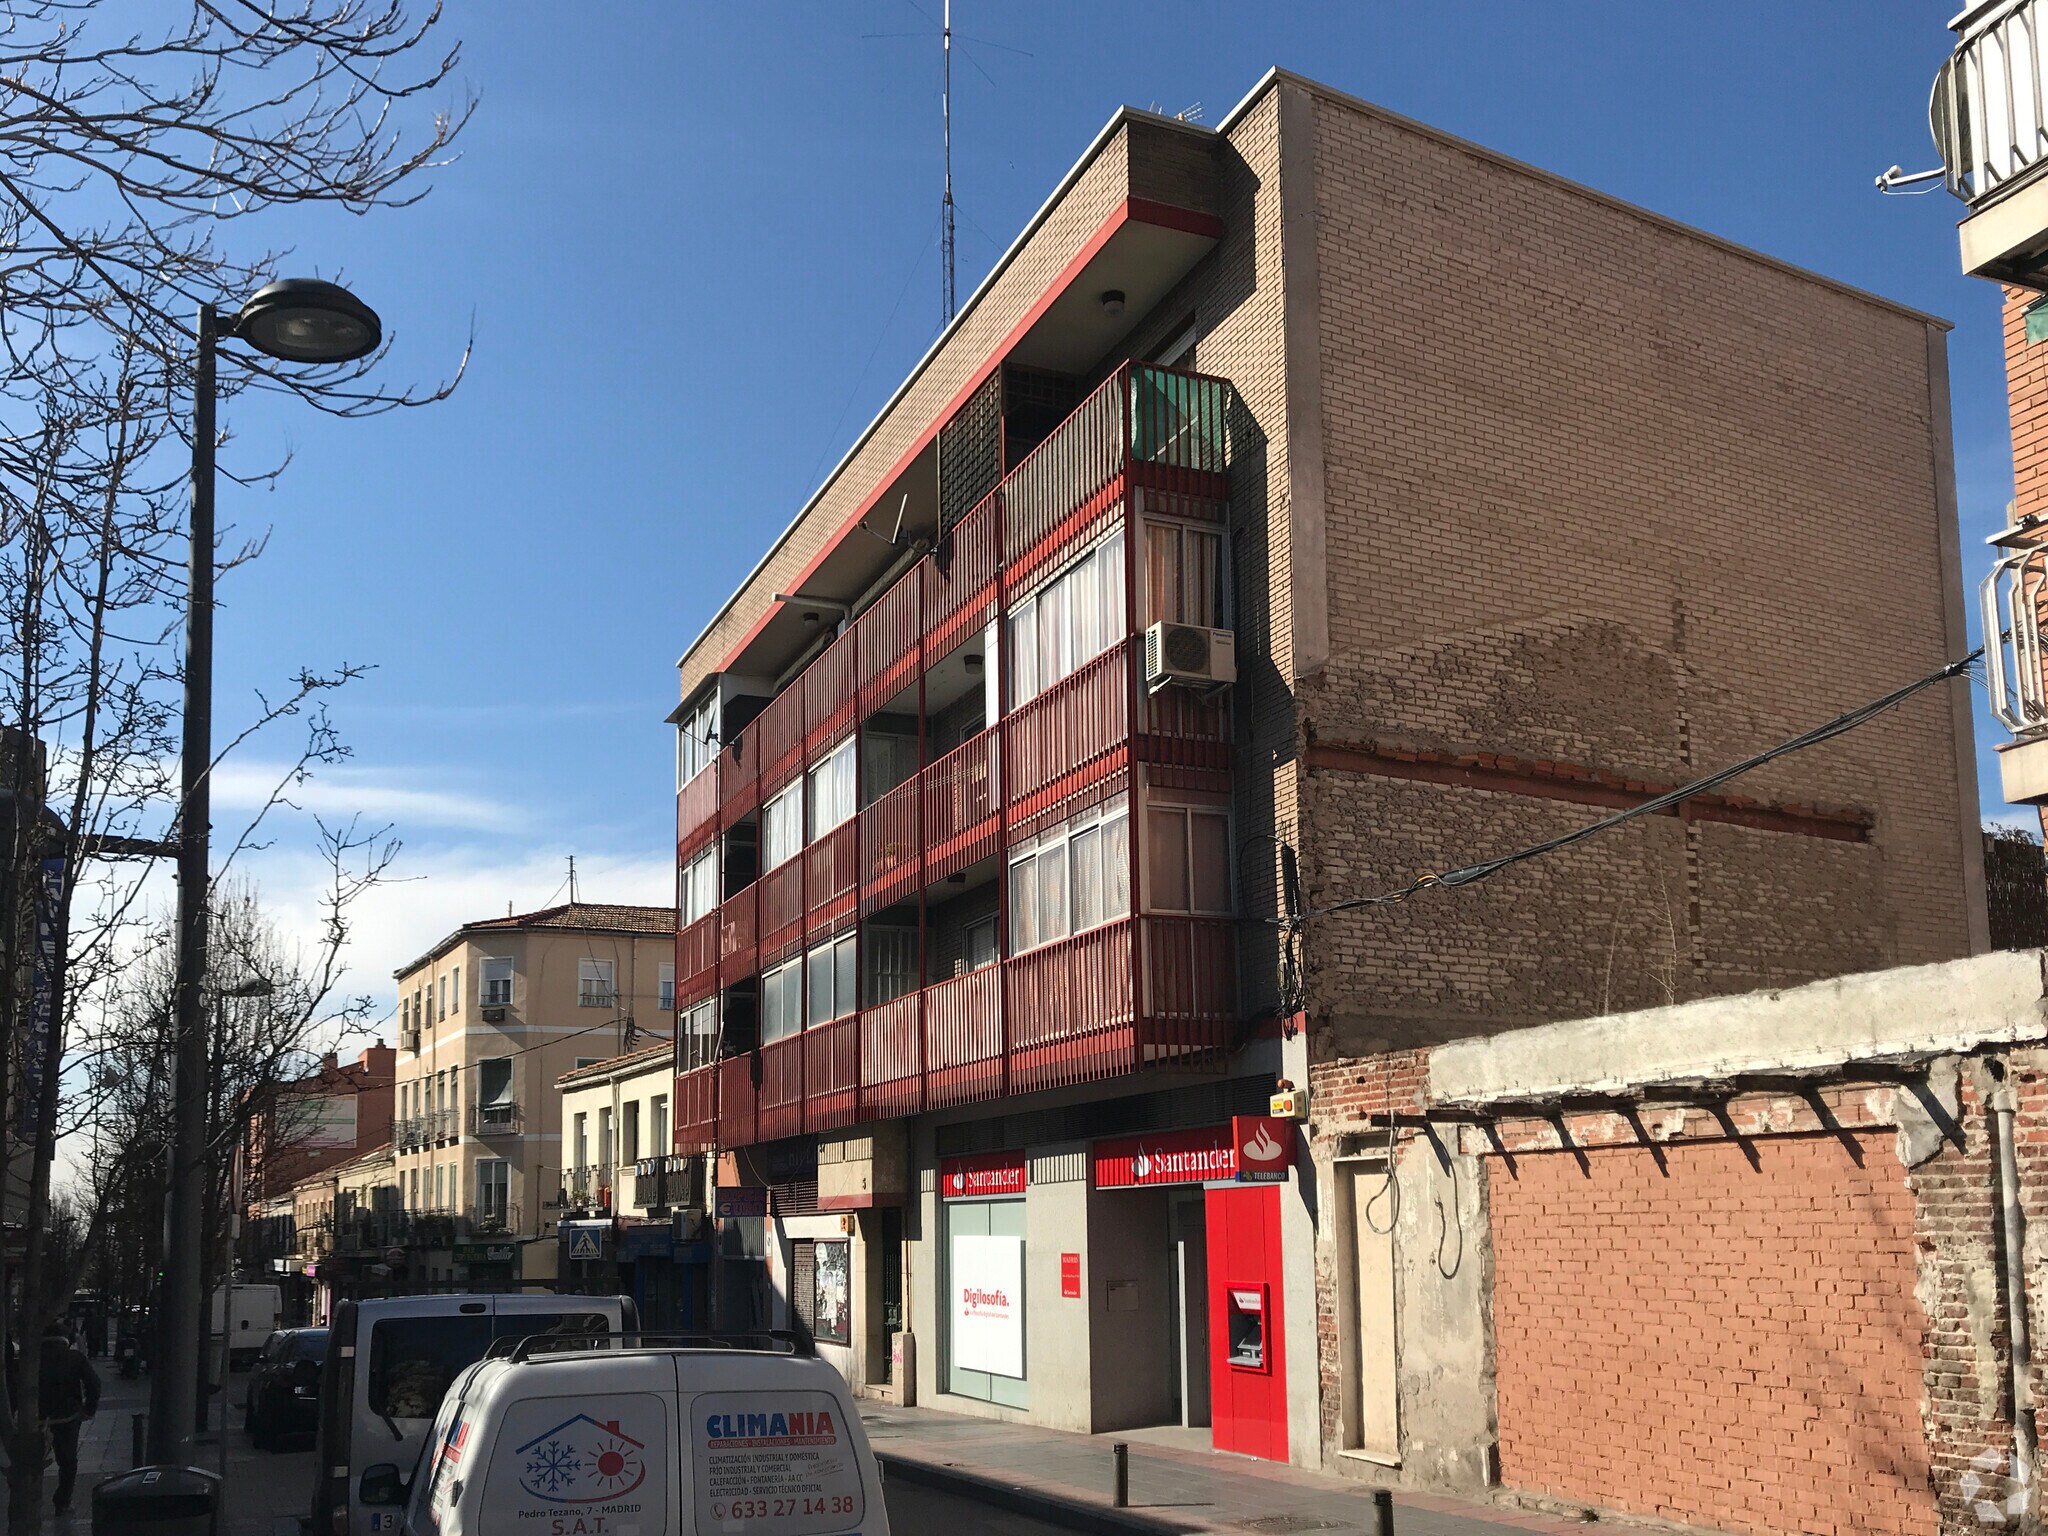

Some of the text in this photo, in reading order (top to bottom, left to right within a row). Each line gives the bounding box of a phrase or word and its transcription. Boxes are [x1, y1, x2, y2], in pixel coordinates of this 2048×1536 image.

[1154, 1139, 1236, 1174] Santander
[967, 1164, 1020, 1189] Santander
[1254, 1171, 1286, 1181] TELEBANCO
[964, 1288, 1010, 1308] Digilosofía.
[706, 1412, 835, 1438] CLIMANIA
[708, 1453, 752, 1465] CLIMATIZACIÓN
[752, 1453, 785, 1463] INDUSTRIAL
[790, 1452, 820, 1462] DOMÉSTICA
[708, 1465, 724, 1476] FRÍO
[724, 1464, 756, 1475] INDUSTRIAL
[762, 1464, 792, 1474] COMERCIAL
[709, 1475, 746, 1487] CALEFACCIÓN
[750, 1474, 784, 1484] FONTANERÍA
[709, 1486, 748, 1498] ELECTRICIDAD
[752, 1486, 778, 1496] SERVICIO
[778, 1484, 801, 1494] TÉCNICO
[802, 1484, 822, 1493] OFICIAL
[518, 1509, 546, 1519] Pedro
[548, 1508, 584, 1518] Tezano,
[586, 1506, 593, 1515] 7
[601, 1504, 642, 1514] MADRID
[731, 1495, 854, 1520] 633 27 14 38
[551, 1516, 610, 1536] S.A.T.
